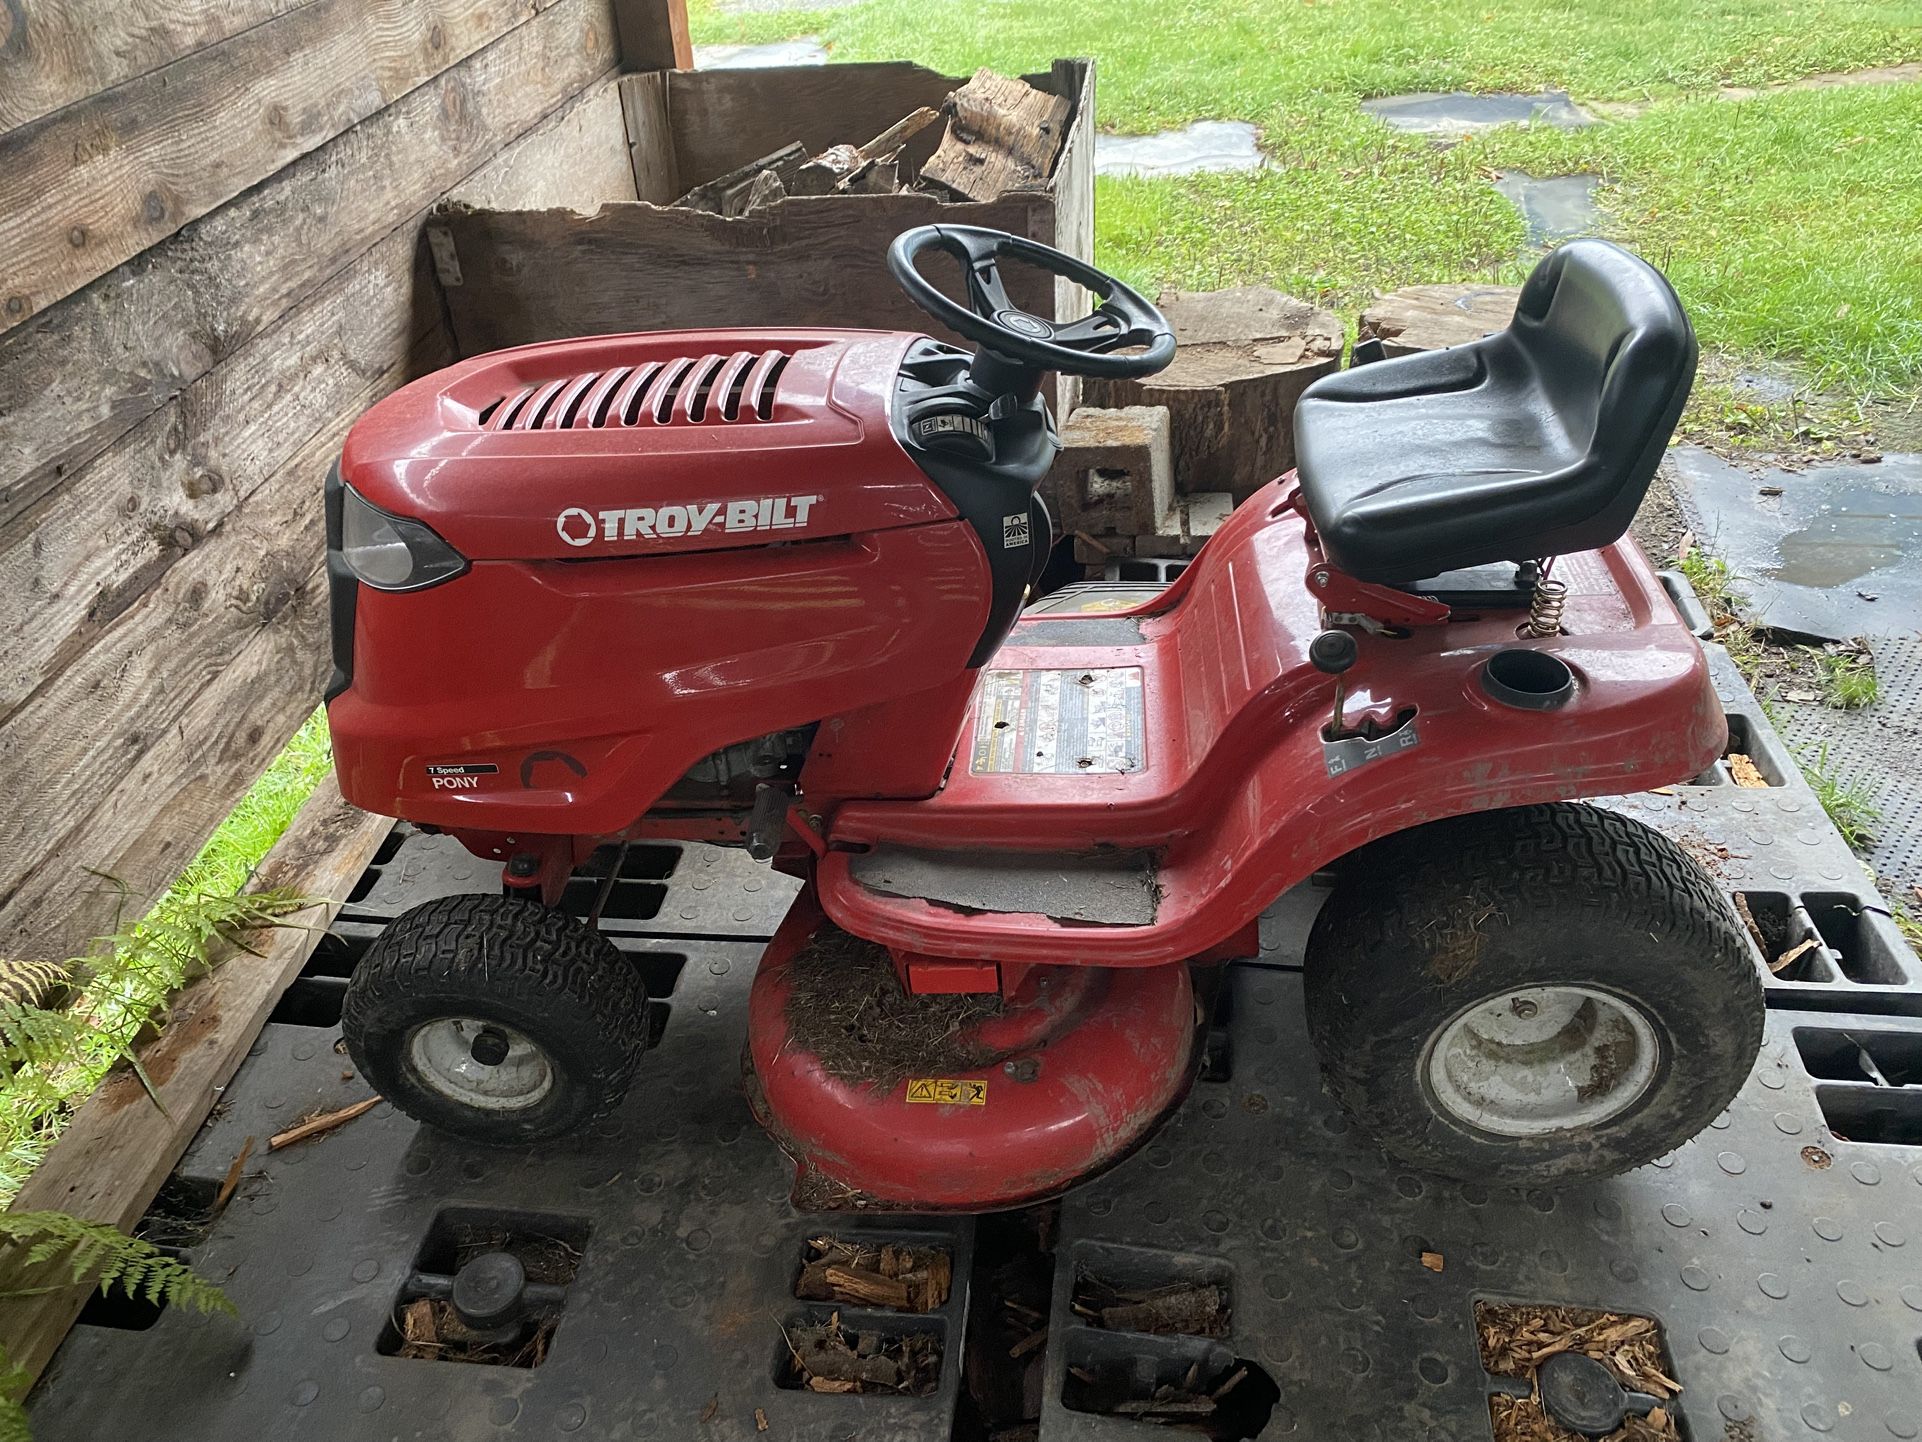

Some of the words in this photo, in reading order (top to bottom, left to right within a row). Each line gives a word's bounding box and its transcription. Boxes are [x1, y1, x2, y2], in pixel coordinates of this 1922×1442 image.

[598, 495, 817, 541] TROY-BILT
[1400, 734, 1414, 747] R
[1364, 747, 1378, 760] N
[1330, 763, 1342, 774] F
[432, 777, 478, 789] PONY
